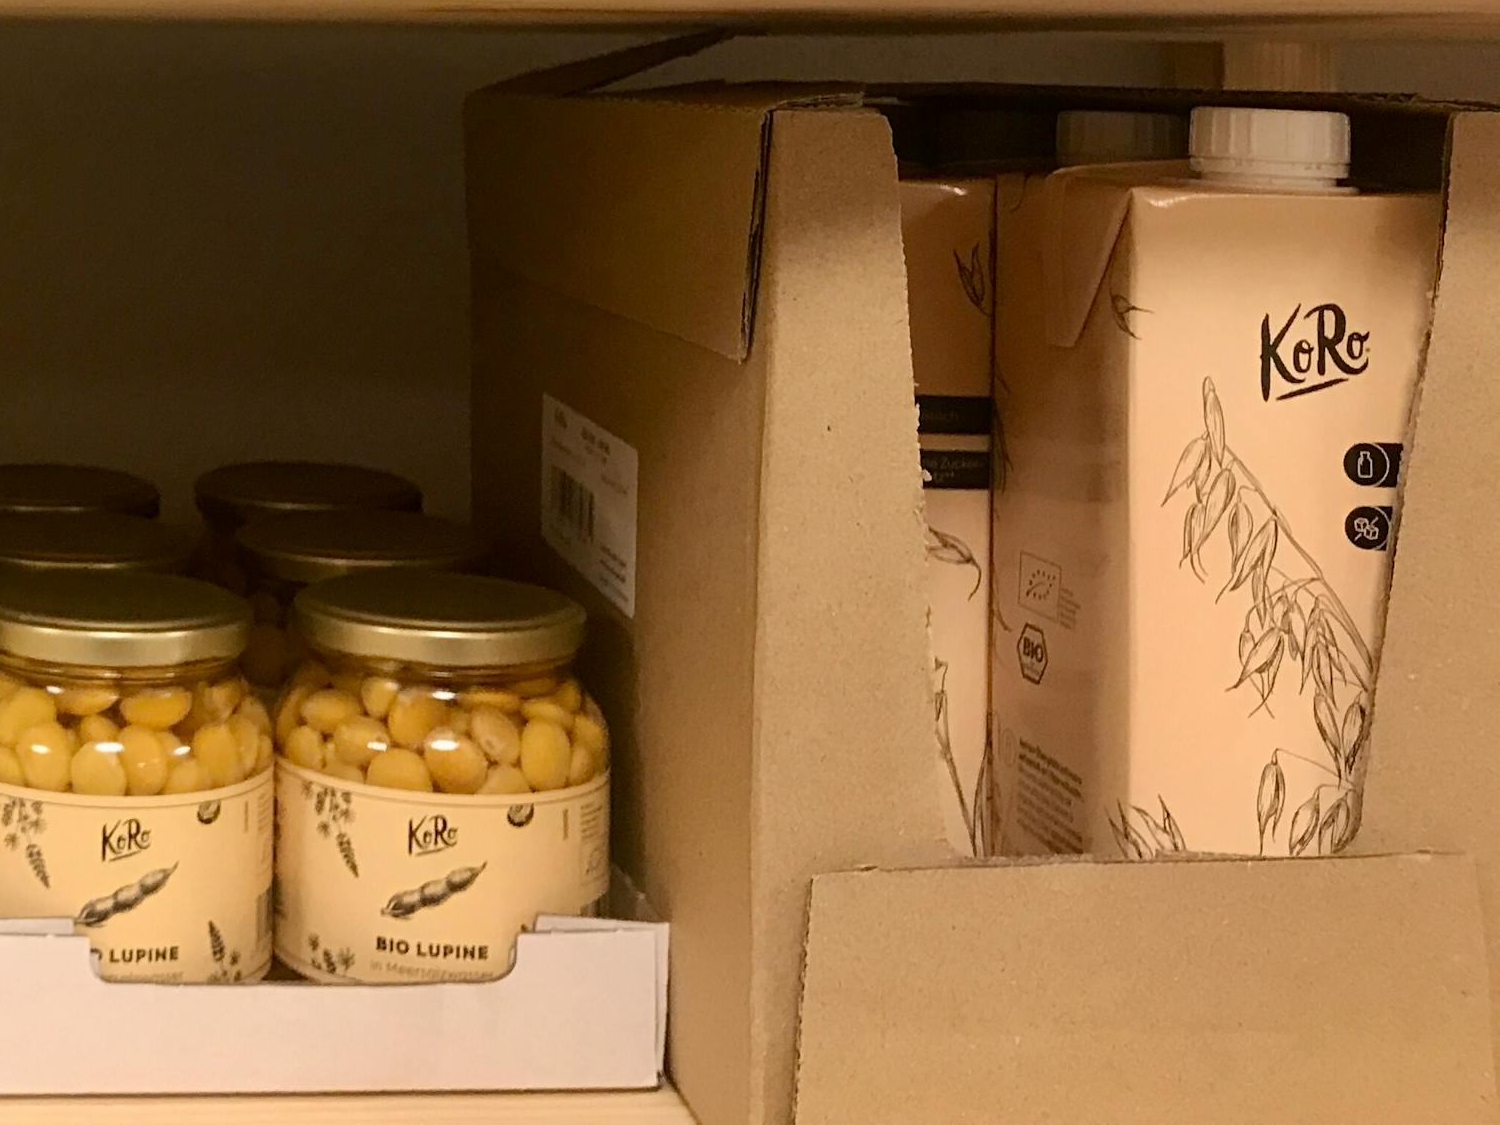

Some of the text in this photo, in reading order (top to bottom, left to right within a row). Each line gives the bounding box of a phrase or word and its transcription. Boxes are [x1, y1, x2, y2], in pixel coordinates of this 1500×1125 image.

[1259, 302, 1370, 402] KoRo
[1022, 636, 1044, 663] BIO
[101, 818, 151, 862] KoRo
[408, 814, 457, 856] KoRo
[109, 946, 179, 963] LUPINE
[376, 935, 489, 961] BIO LUPINE
